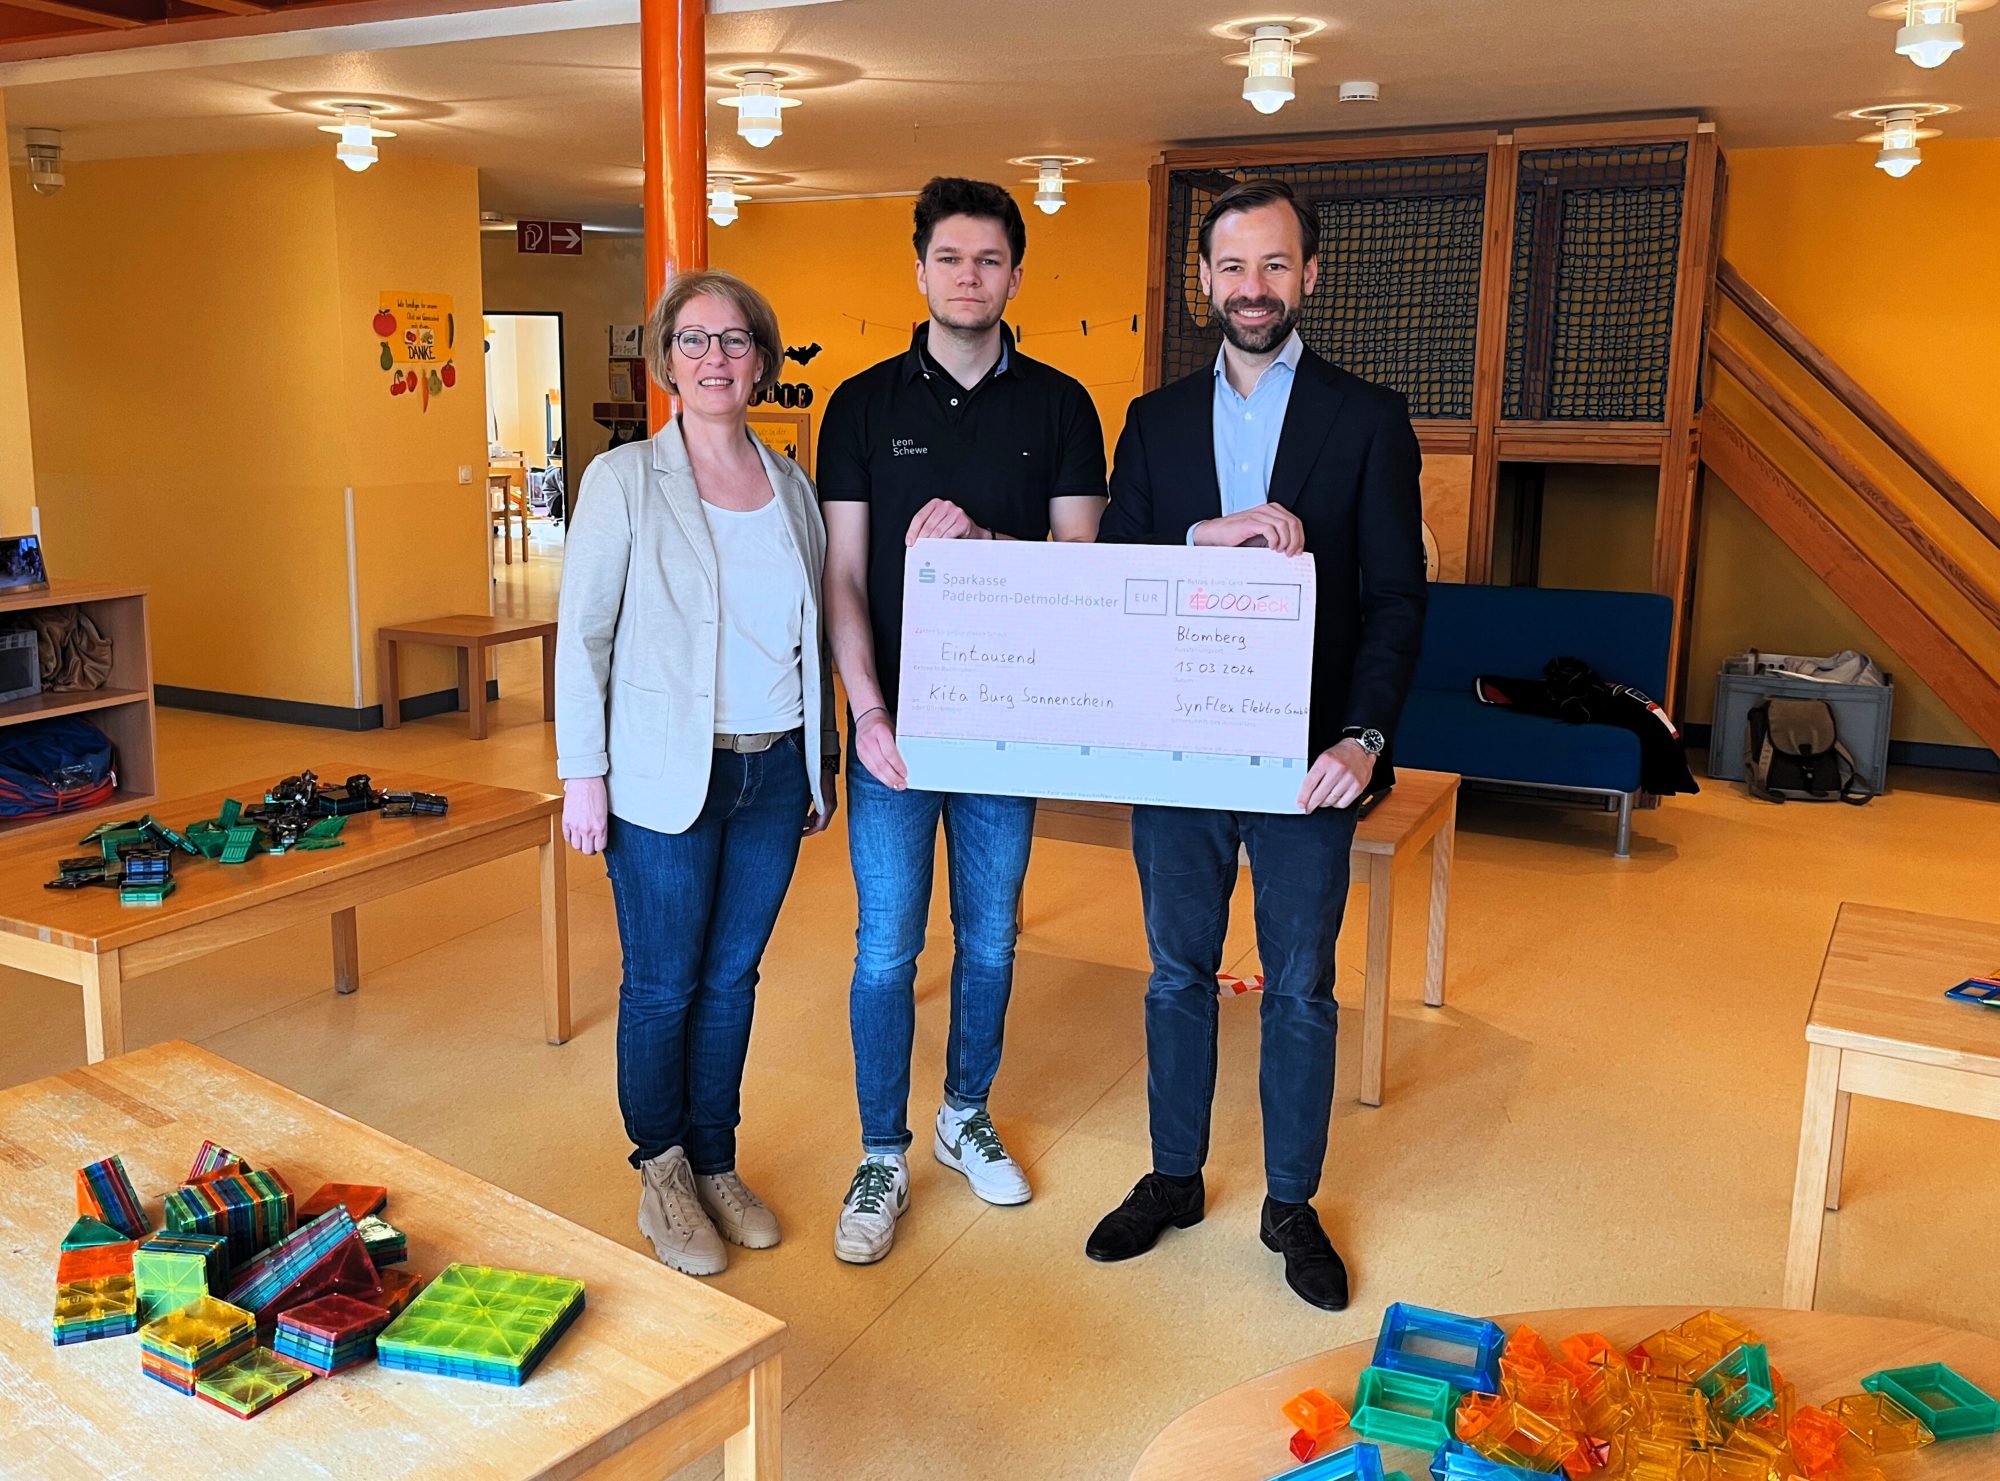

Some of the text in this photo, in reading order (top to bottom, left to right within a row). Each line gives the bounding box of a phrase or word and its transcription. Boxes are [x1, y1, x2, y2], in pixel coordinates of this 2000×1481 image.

[408, 345, 436, 360] DANKE
[892, 438, 914, 447] Leon
[893, 446, 928, 457] Schewe
[943, 573, 1007, 587] Sparkasse
[942, 590, 1119, 608] Paderborn-Detmold-Höxter
[1135, 593, 1158, 603] EUR
[1177, 625, 1247, 650] Blomberg
[941, 642, 1036, 665] Eintausend
[1223, 664, 1254, 674] 2024
[929, 683, 1114, 709] Kita Burg Sonnenschein
[1242, 698, 1281, 714] Elektro
